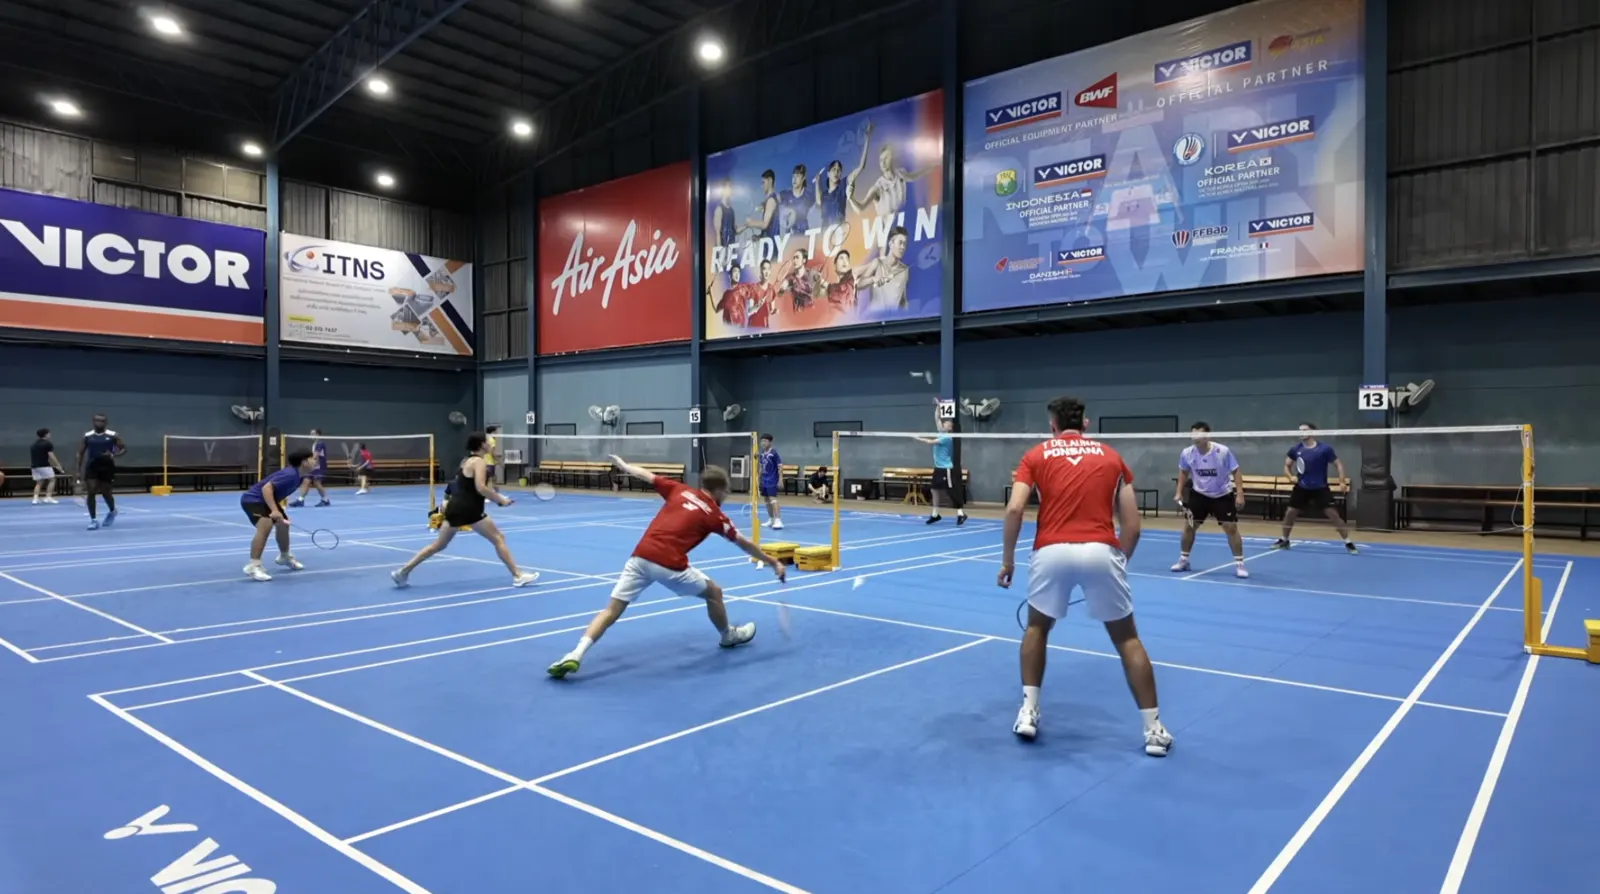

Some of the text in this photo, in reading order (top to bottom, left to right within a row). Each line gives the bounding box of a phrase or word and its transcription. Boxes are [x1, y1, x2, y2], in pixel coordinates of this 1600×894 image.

[1157, 60, 1329, 107] OFFICIAL PARTNER
[1079, 86, 1114, 104] BWF
[1006, 97, 1058, 118] VICTOR
[984, 113, 1118, 151] OFFICIAL EQUIPMENT PARTNER
[1251, 119, 1311, 140] VICTOR
[1054, 158, 1102, 175] VICTOR
[1204, 160, 1258, 177] KOREA
[1197, 174, 1236, 188] OFFICIAL
[1238, 166, 1281, 181] PARTNER
[1005, 191, 1080, 211] INDONESIA
[1020, 206, 1052, 218] OFFICIAL
[1053, 200, 1089, 213] PARTNER
[1266, 215, 1311, 229] VICTOR
[0, 218, 251, 290] VICTOR
[710, 232, 792, 274] READY
[805, 223, 845, 259] TO
[1071, 247, 1103, 258] VICTOR
[1210, 244, 1258, 256] FRANCE
[322, 253, 385, 281] ITNS
[1029, 269, 1065, 279] DANISH
[1363, 393, 1384, 407] 13
[691, 412, 699, 422] 15
[940, 405, 953, 416] 14
[1043, 446, 1105, 460] PONSANA
